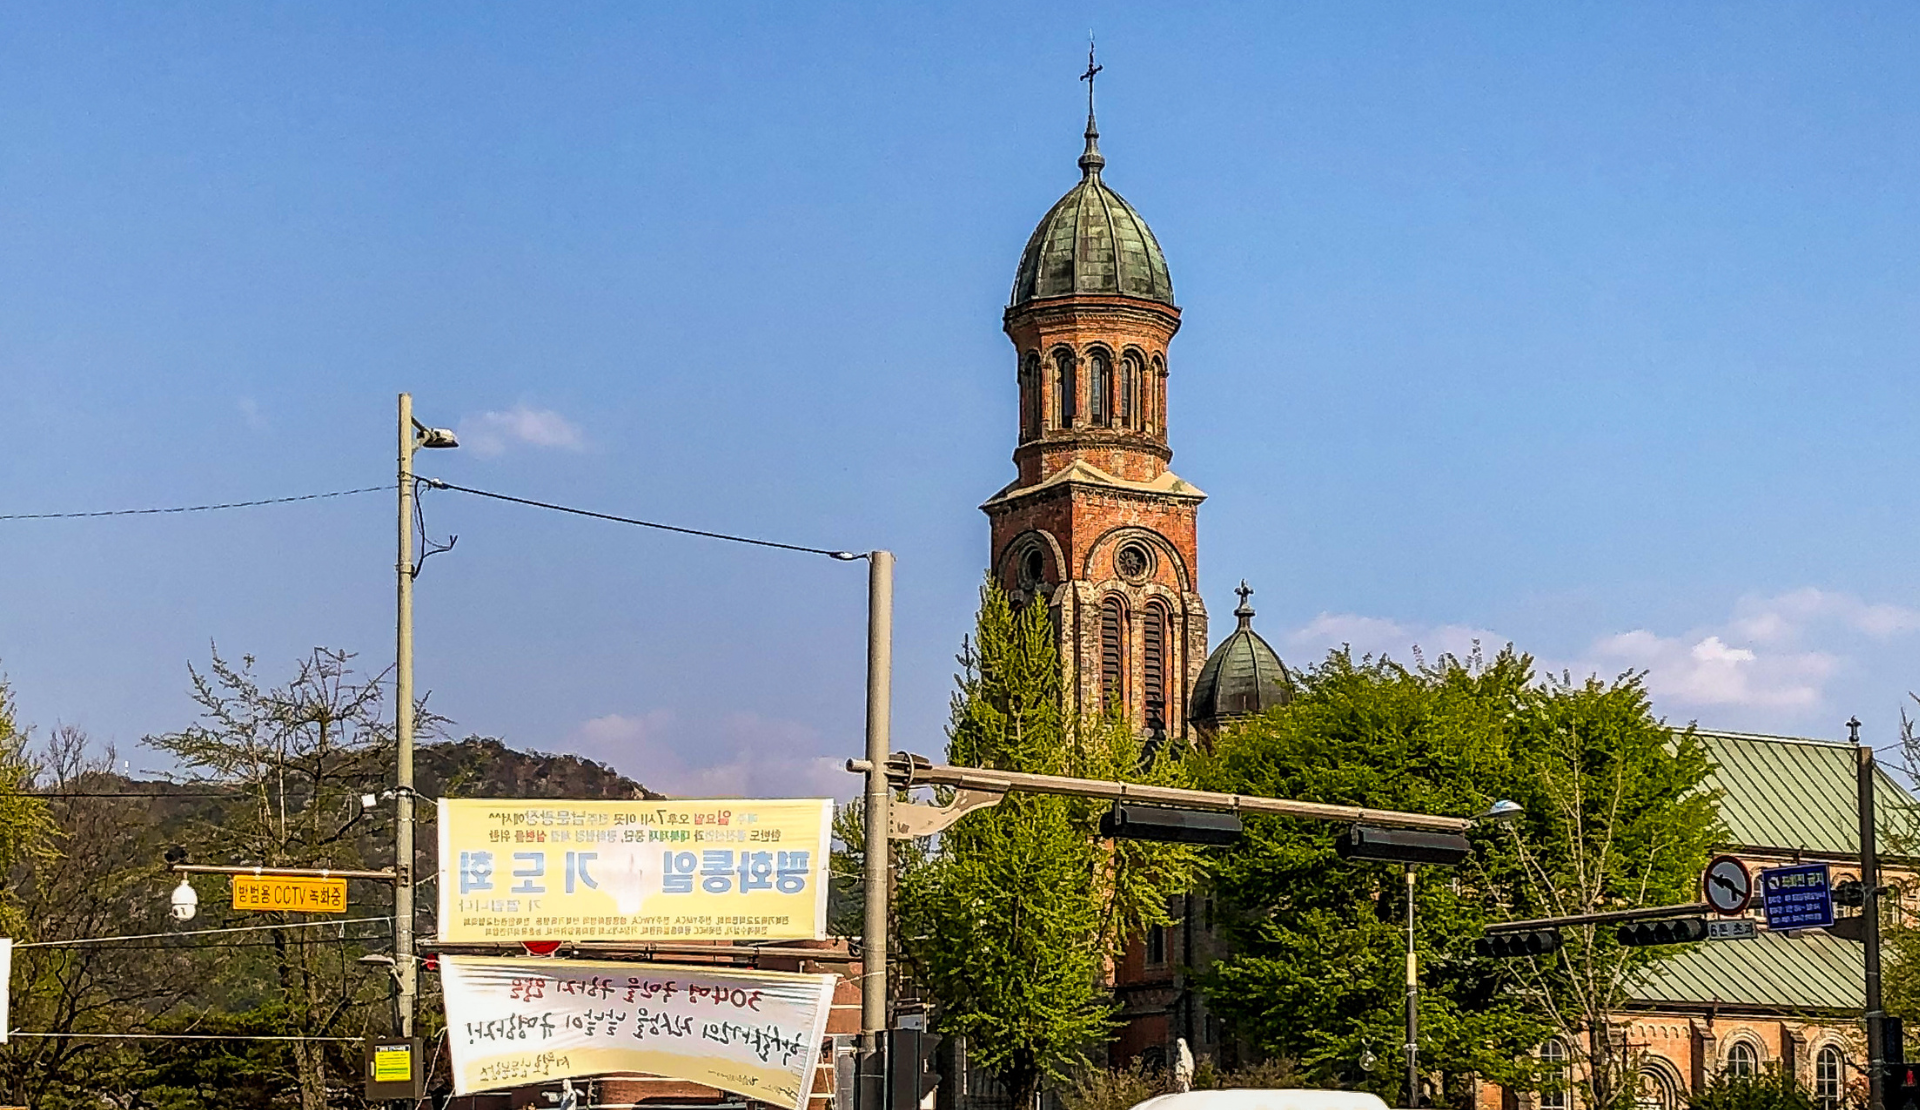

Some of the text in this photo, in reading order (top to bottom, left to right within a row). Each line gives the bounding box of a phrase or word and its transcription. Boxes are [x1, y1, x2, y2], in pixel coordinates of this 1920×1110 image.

[238, 884, 341, 906] 방범용 CCTV 녹화중
